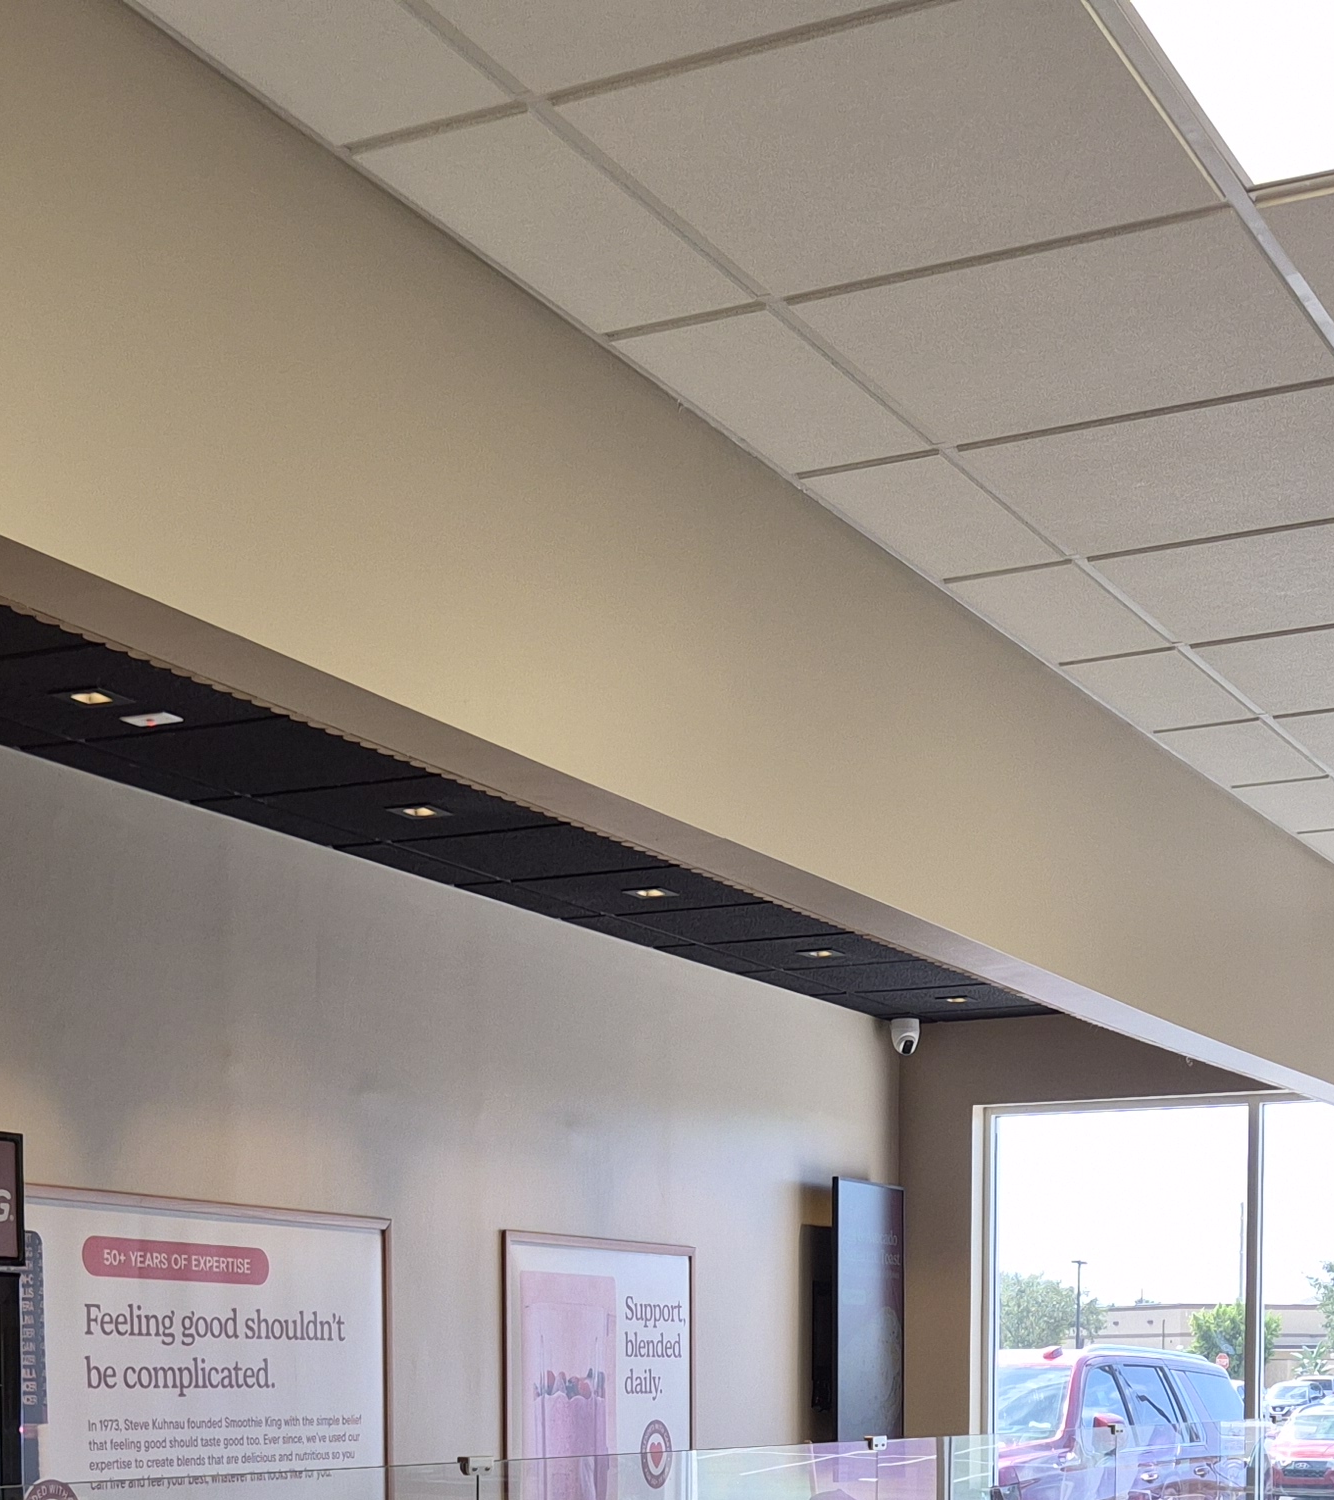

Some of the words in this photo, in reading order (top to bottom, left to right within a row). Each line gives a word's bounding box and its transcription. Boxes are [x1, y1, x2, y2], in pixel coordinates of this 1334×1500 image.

[103, 1248, 126, 1266] 50+
[129, 1250, 168, 1269] YEARS
[171, 1253, 188, 1270] OF
[191, 1255, 251, 1274] EXPERTISE
[84, 1303, 175, 1346] Feeling
[181, 1307, 239, 1346] good
[244, 1308, 346, 1342] shouldn't
[625, 1295, 686, 1328] Support,
[625, 1331, 682, 1359] blended
[84, 1355, 117, 1389] be
[123, 1356, 276, 1397] complicated.
[624, 1368, 663, 1401] daily.
[87, 1419, 97, 1432] In
[99, 1418, 122, 1433] 1973,
[124, 1418, 149, 1431] Steve
[152, 1418, 185, 1431] Kuhnau
[187, 1417, 223, 1430] founded
[224, 1416, 262, 1428] Smoothie
[265, 1415, 283, 1430] King
[284, 1415, 300, 1427] with
[302, 1415, 314, 1426] the
[316, 1414, 340, 1427] simple
[88, 1439, 108, 1451] that
[110, 1438, 142, 1452] feeling
[144, 1437, 167, 1452] good
[169, 1436, 198, 1449] should
[200, 1437, 221, 1448] taste
[223, 1434, 244, 1449] good
[246, 1435, 262, 1446] too.
[263, 1433, 280, 1446] Ever
[282, 1432, 305, 1445] since,
[328, 1431, 347, 1443] used
[348, 1433, 360, 1442] our
[89, 1457, 132, 1473] expertise
[134, 1458, 144, 1469] to
[146, 1457, 174, 1469] create
[176, 1454, 206, 1467] blends
[207, 1454, 224, 1466] that
[226, 1455, 240, 1465] are
[241, 1452, 277, 1464] delicious
[278, 1450, 294, 1463] and
[295, 1449, 331, 1461] nutritious
[331, 1450, 341, 1460] so
[342, 1449, 355, 1461] you
[49, 1484, 68, 1499] WITH
